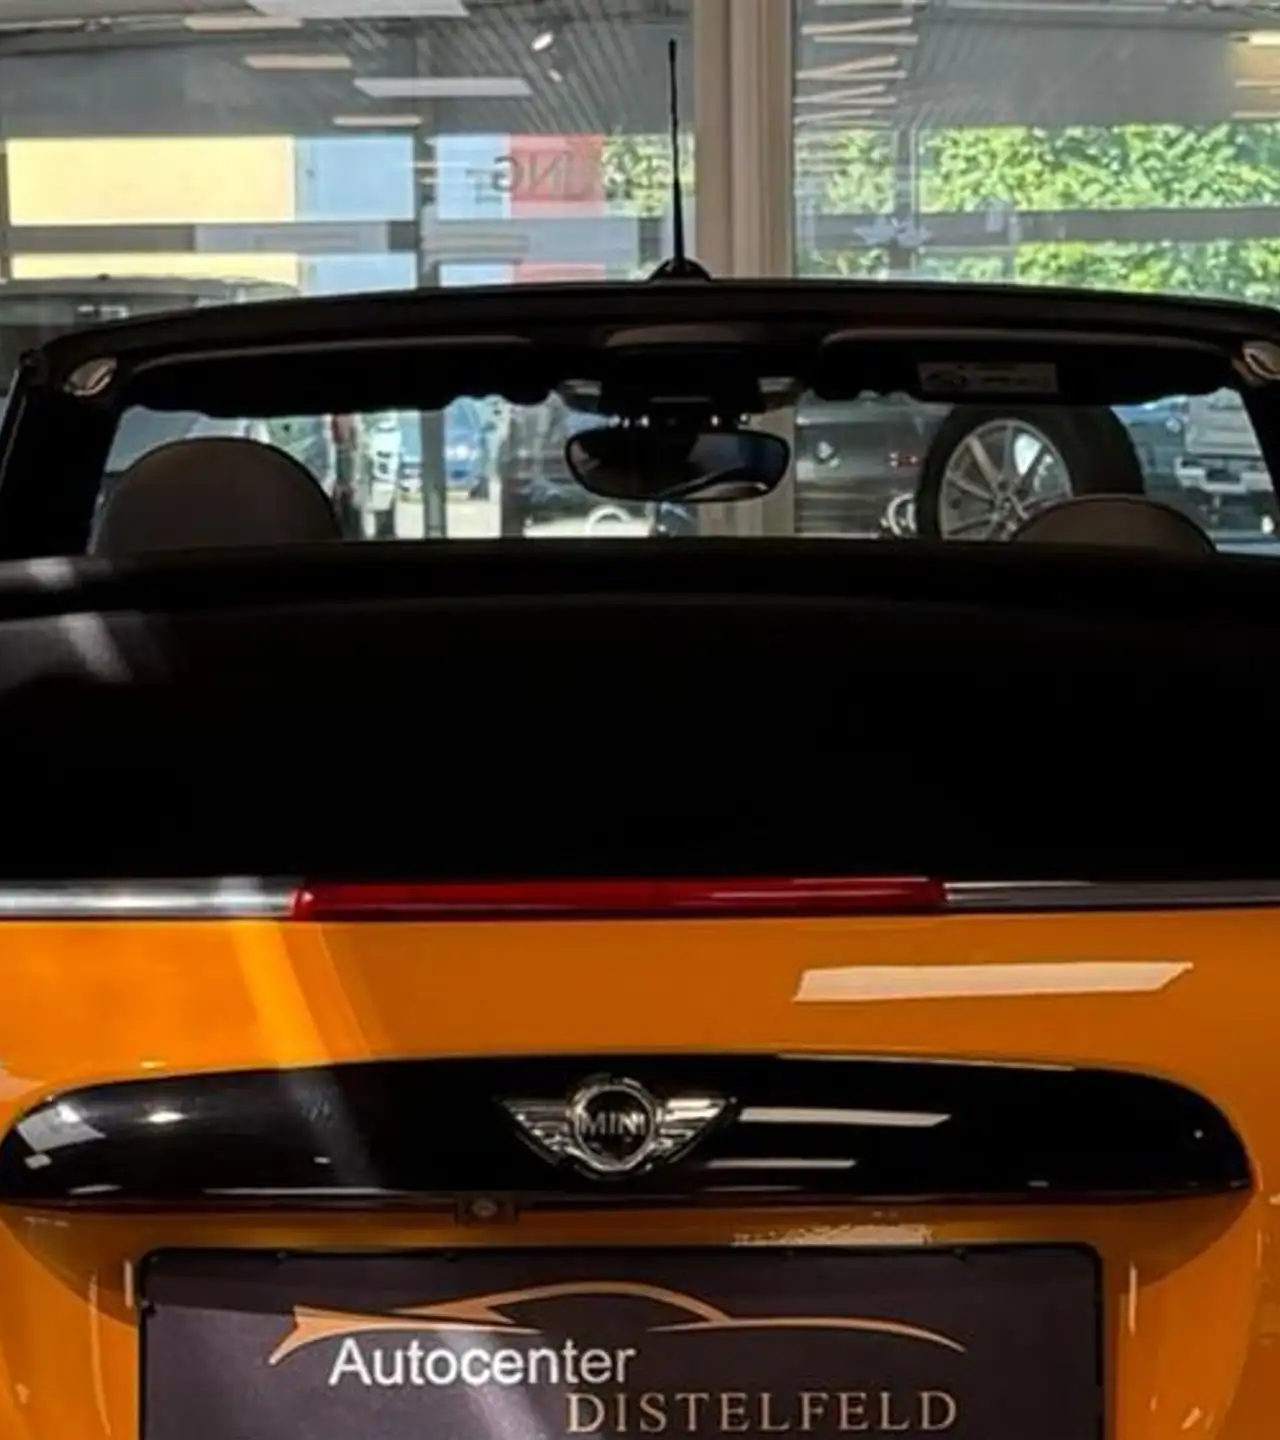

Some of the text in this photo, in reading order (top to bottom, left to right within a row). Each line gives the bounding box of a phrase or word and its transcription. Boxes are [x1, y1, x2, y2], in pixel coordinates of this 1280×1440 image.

[582, 1110, 646, 1136] MINI
[328, 1338, 636, 1386] Autocenter
[565, 1390, 958, 1434] DISTELFELD
